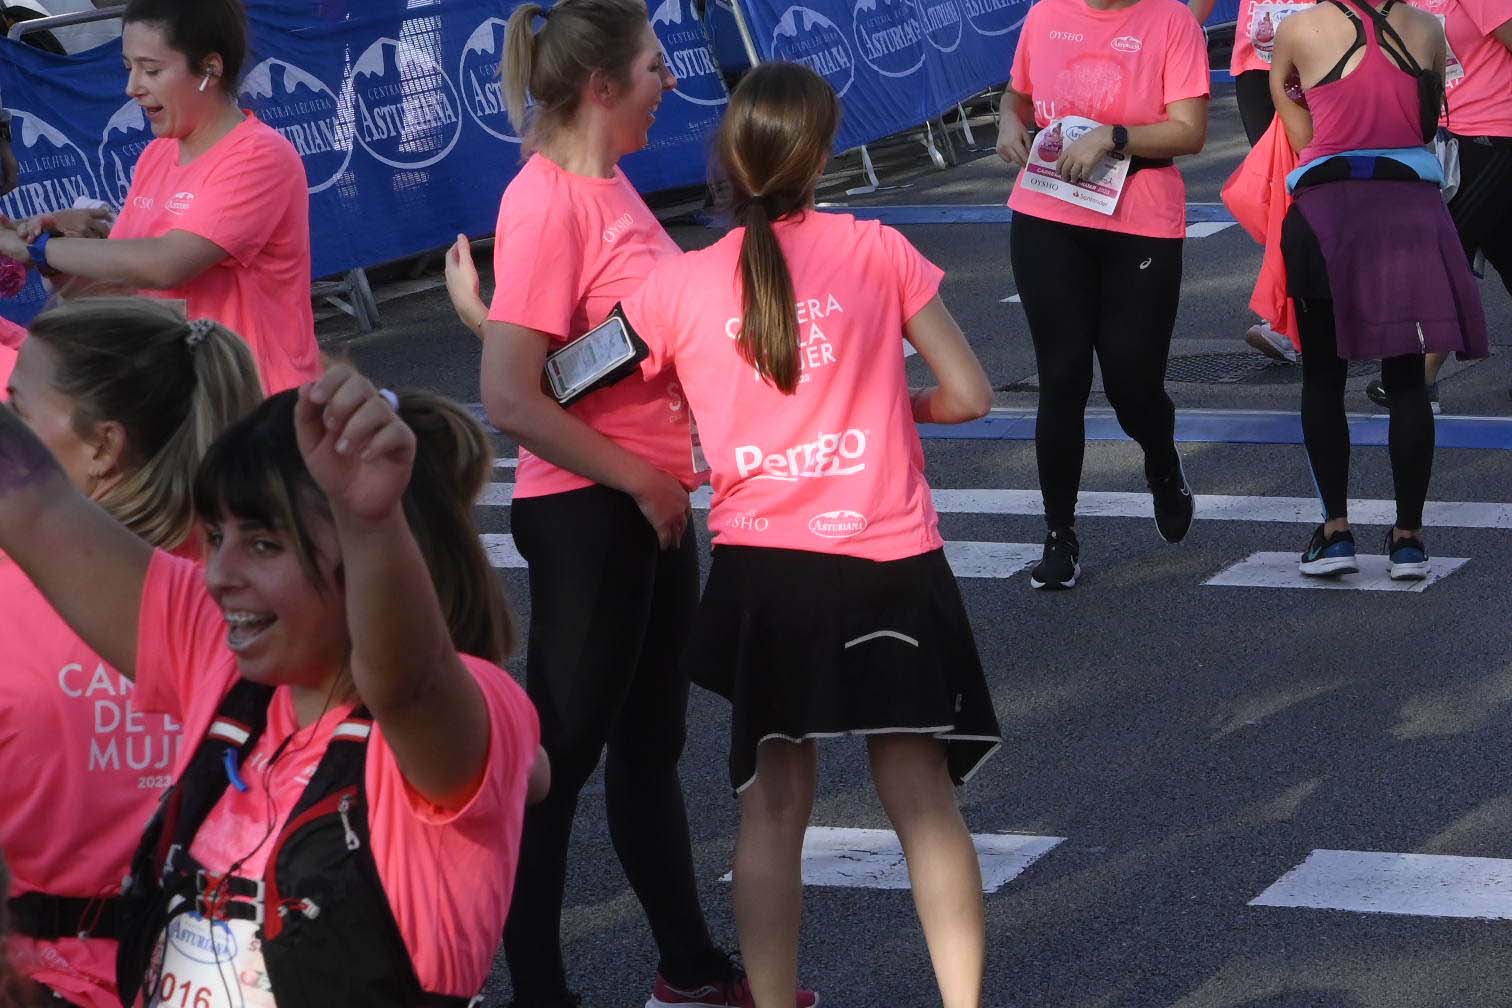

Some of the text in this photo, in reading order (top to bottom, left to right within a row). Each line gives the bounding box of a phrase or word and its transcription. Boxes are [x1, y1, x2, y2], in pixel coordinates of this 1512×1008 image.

[1049, 30, 1084, 43] OYSHO
[1036, 100, 1056, 121] TU
[1030, 177, 1059, 192] OYSHO
[814, 518, 863, 532] ASTURIANA
[161, 971, 212, 1008] 016
